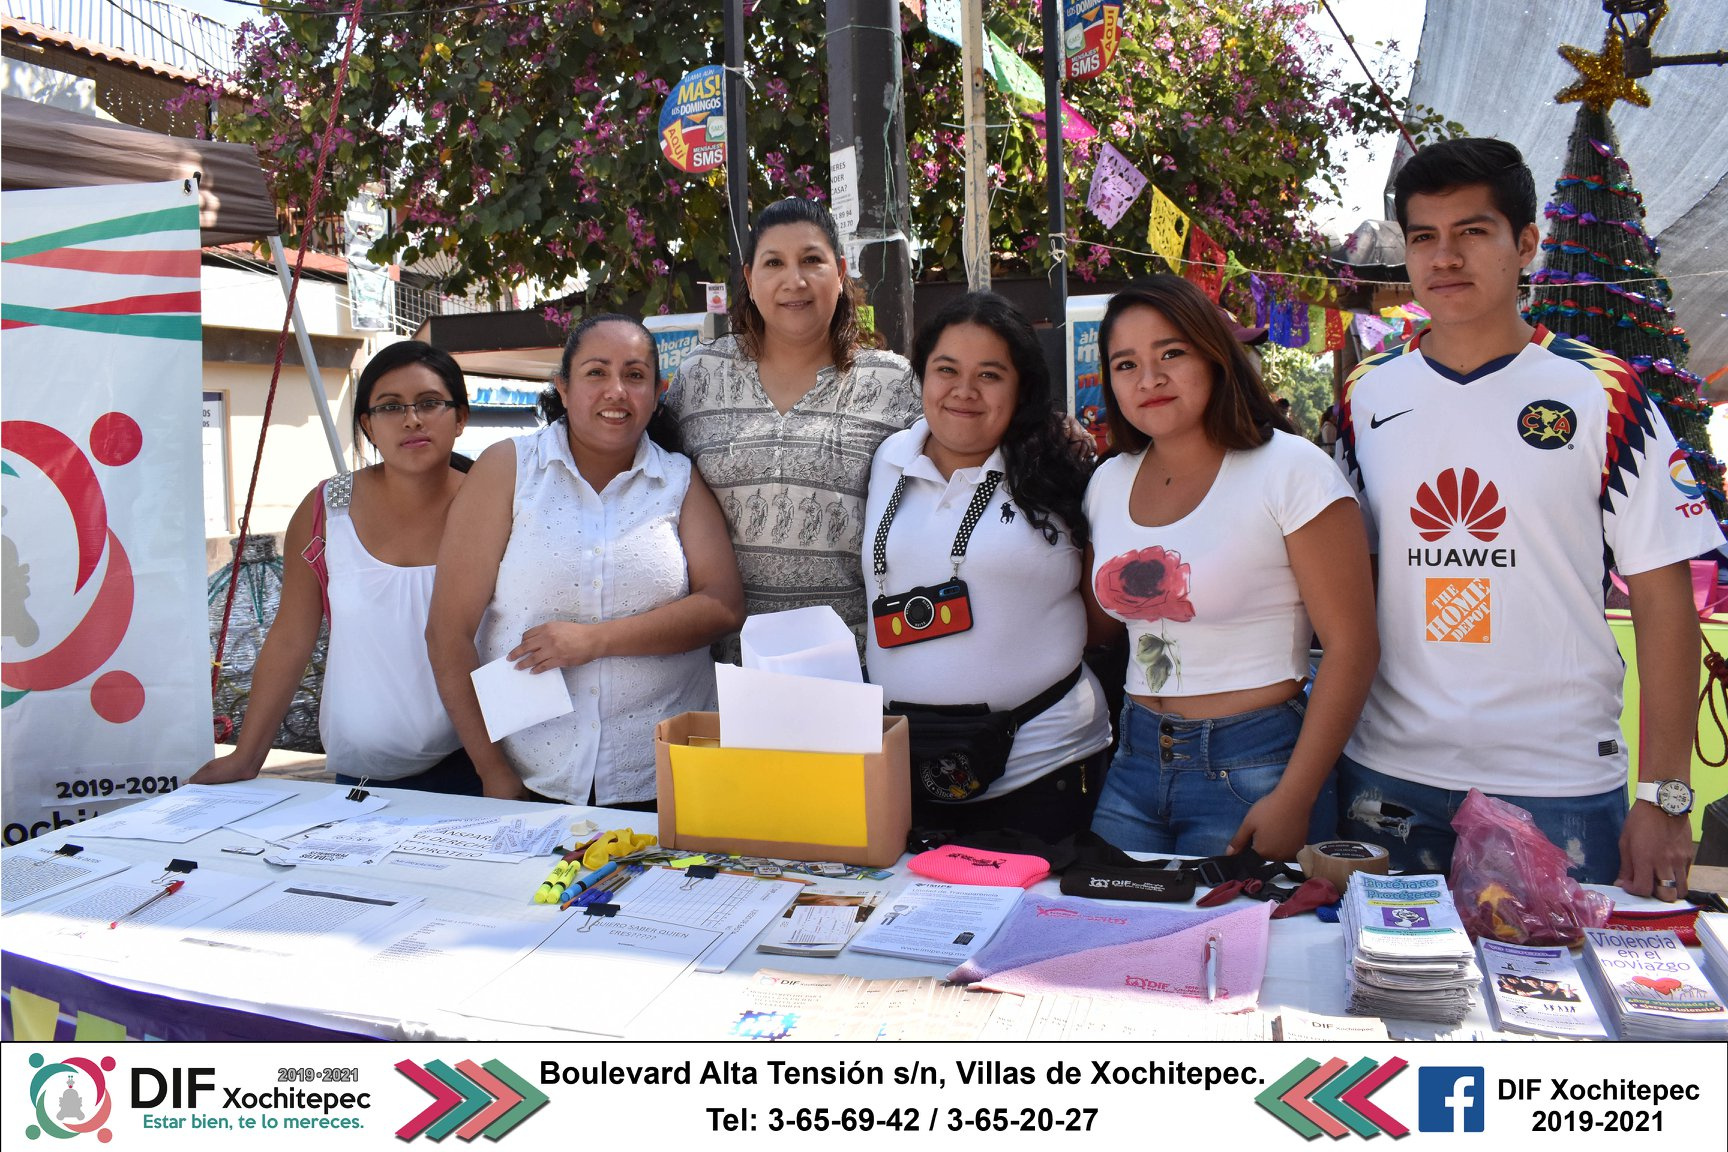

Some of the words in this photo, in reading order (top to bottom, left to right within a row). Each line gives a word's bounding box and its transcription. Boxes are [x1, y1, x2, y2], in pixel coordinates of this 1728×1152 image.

[1071, 54, 1100, 77] SMS
[672, 106, 680, 116] LOS
[680, 97, 722, 116] DOMINGOS
[693, 149, 723, 167] SMS
[658, 336, 691, 353] horra
[1675, 500, 1711, 518] TOT
[1408, 549, 1516, 567] HUAWEI
[1431, 583, 1460, 611] THE
[1425, 577, 1491, 642] HOME
[1451, 602, 1491, 642] DEPOT
[56, 776, 179, 799] 2019-2021
[628, 925, 657, 934] SABER
[659, 929, 690, 939] QUIEN
[1588, 931, 1677, 949] Violencia
[1618, 949, 1640, 958] en
[1644, 950, 1662, 960] el
[1600, 959, 1691, 973] noviazgo
[1312, 1021, 1334, 1029] DIF
